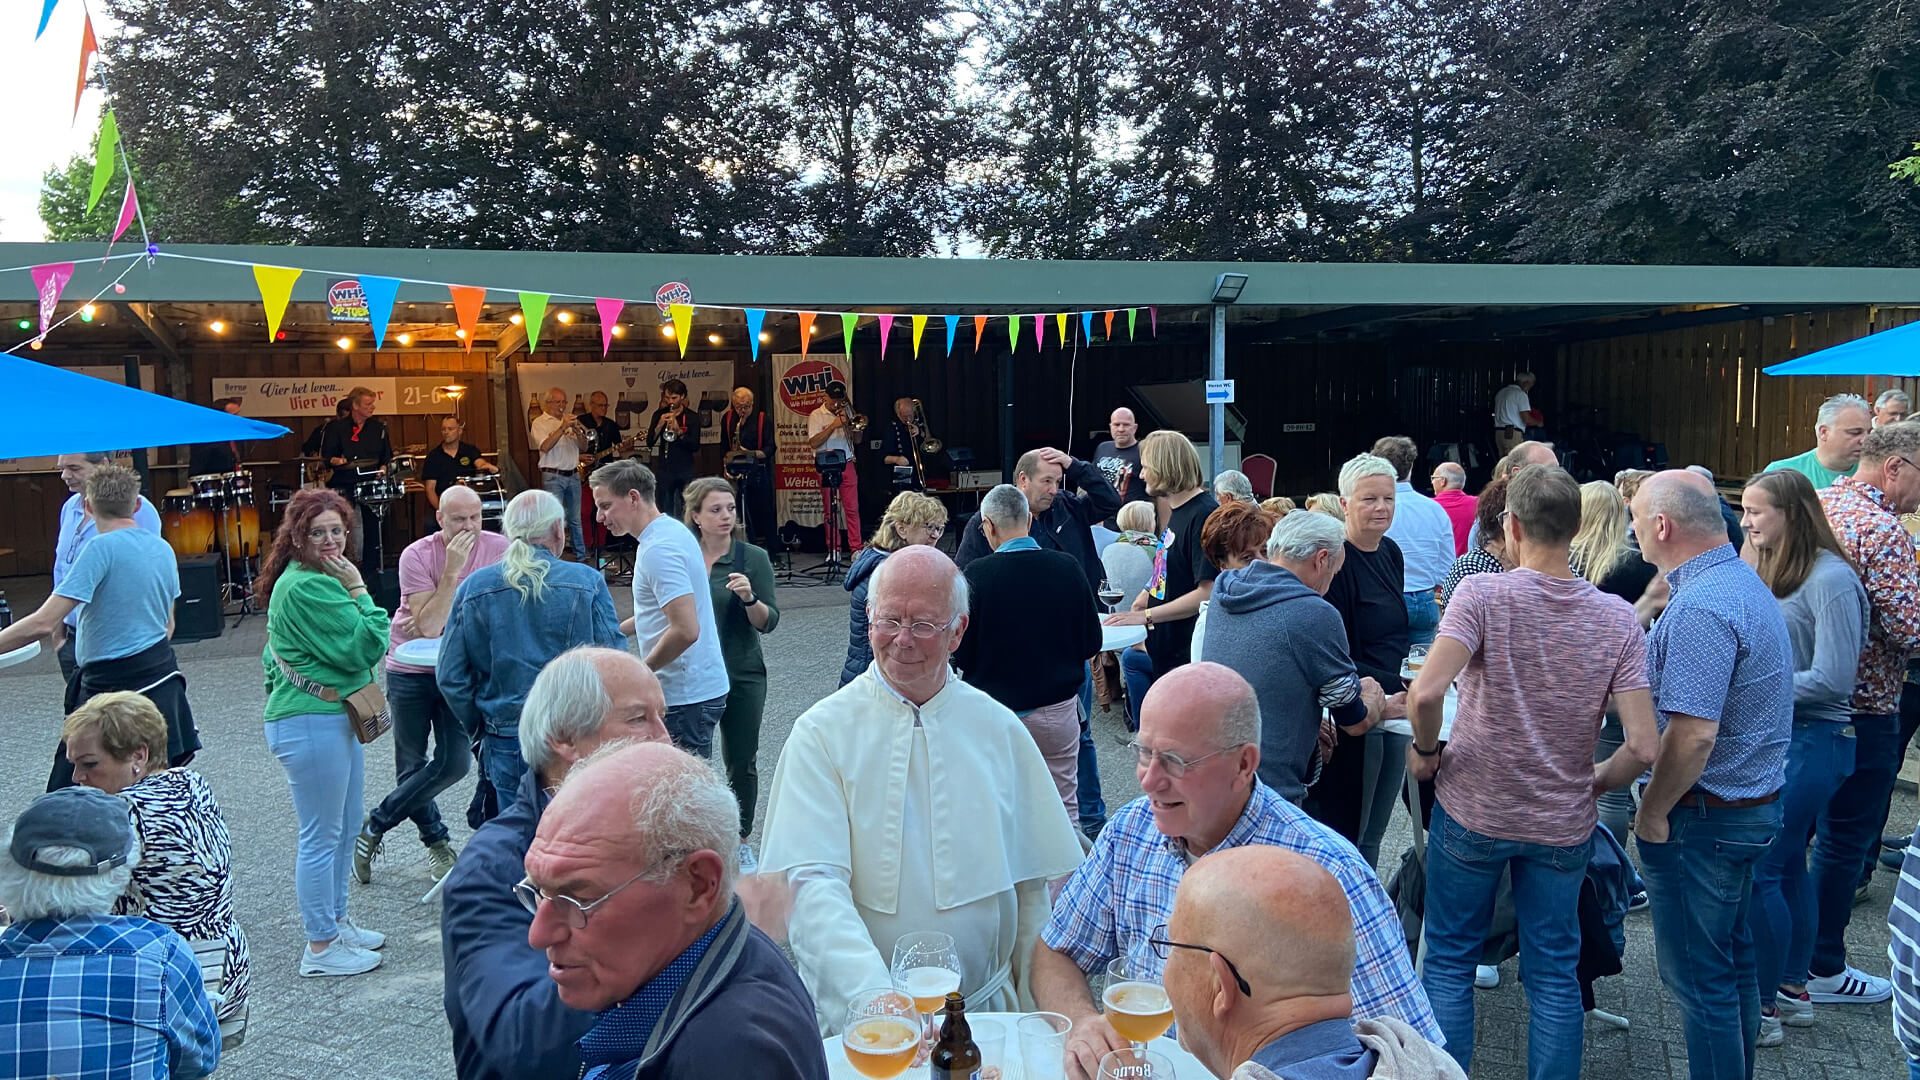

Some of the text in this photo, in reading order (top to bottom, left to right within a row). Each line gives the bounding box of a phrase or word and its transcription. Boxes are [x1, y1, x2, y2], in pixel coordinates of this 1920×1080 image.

[224, 383, 247, 392] Berne
[782, 366, 833, 396] WHi
[260, 382, 290, 398] Vier
[292, 382, 307, 394] het
[290, 395, 318, 411] Vier
[321, 393, 338, 408] de
